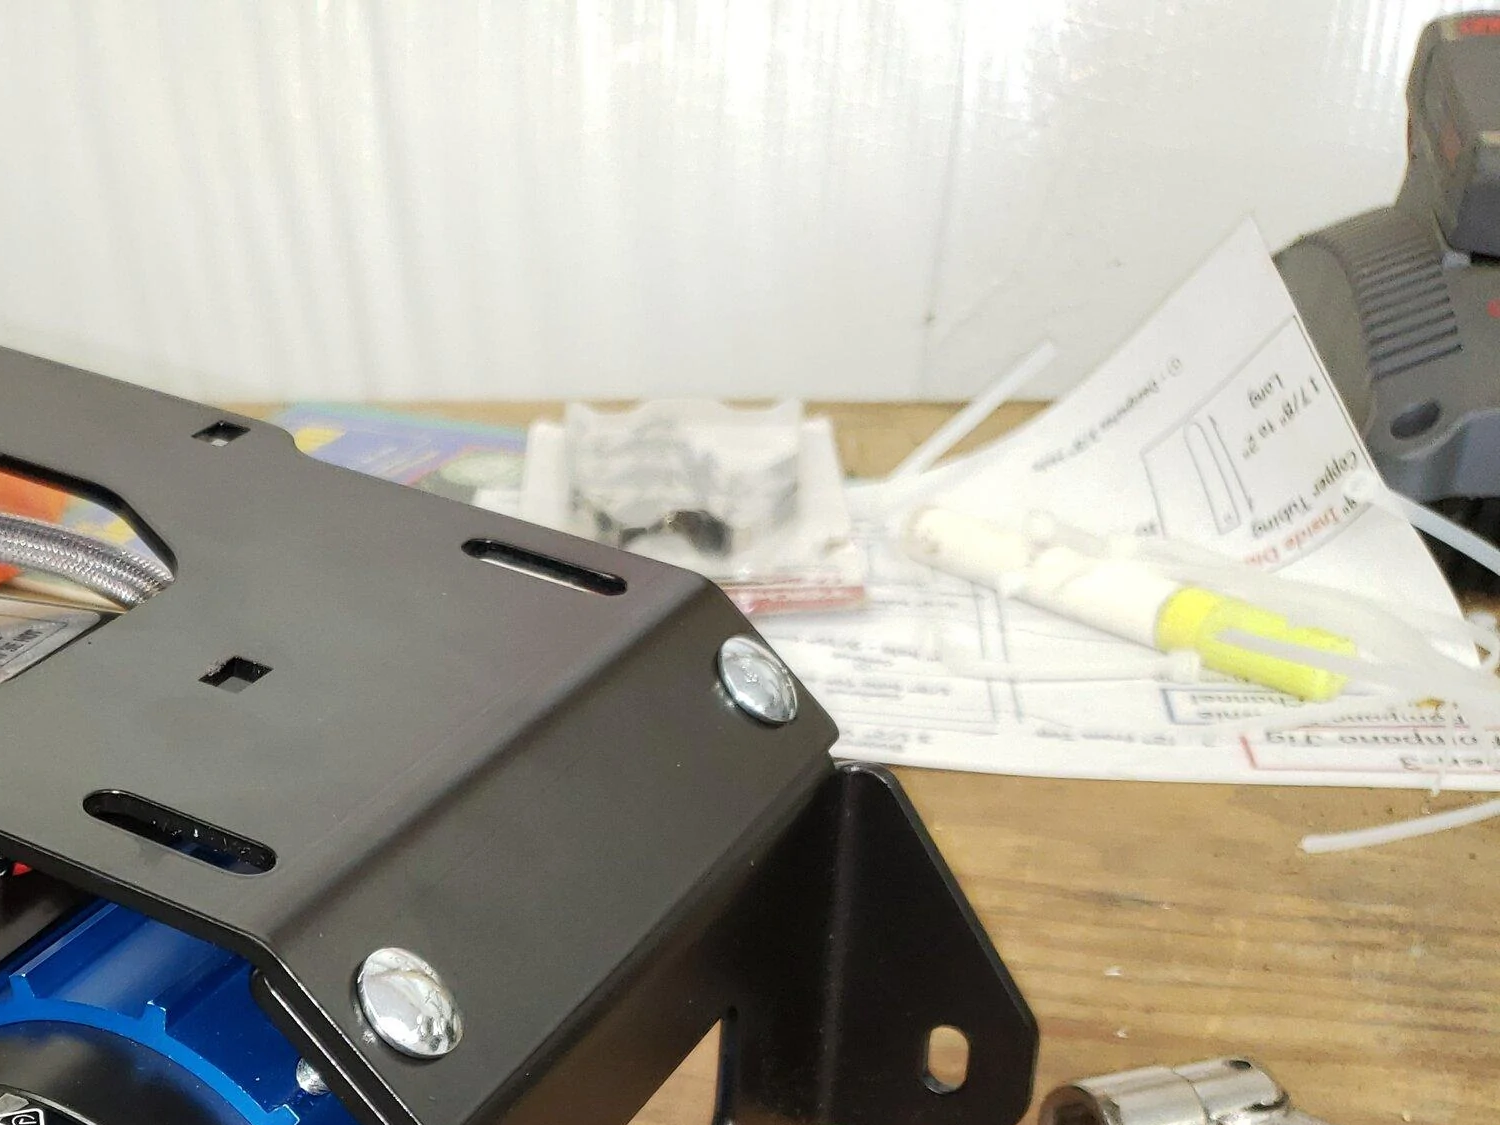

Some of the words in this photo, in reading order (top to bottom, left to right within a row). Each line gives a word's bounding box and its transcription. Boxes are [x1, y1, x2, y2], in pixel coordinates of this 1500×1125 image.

[1249, 373, 1284, 409] Long
[1312, 451, 1359, 497] Copper
[1252, 496, 1310, 538] Tubing
